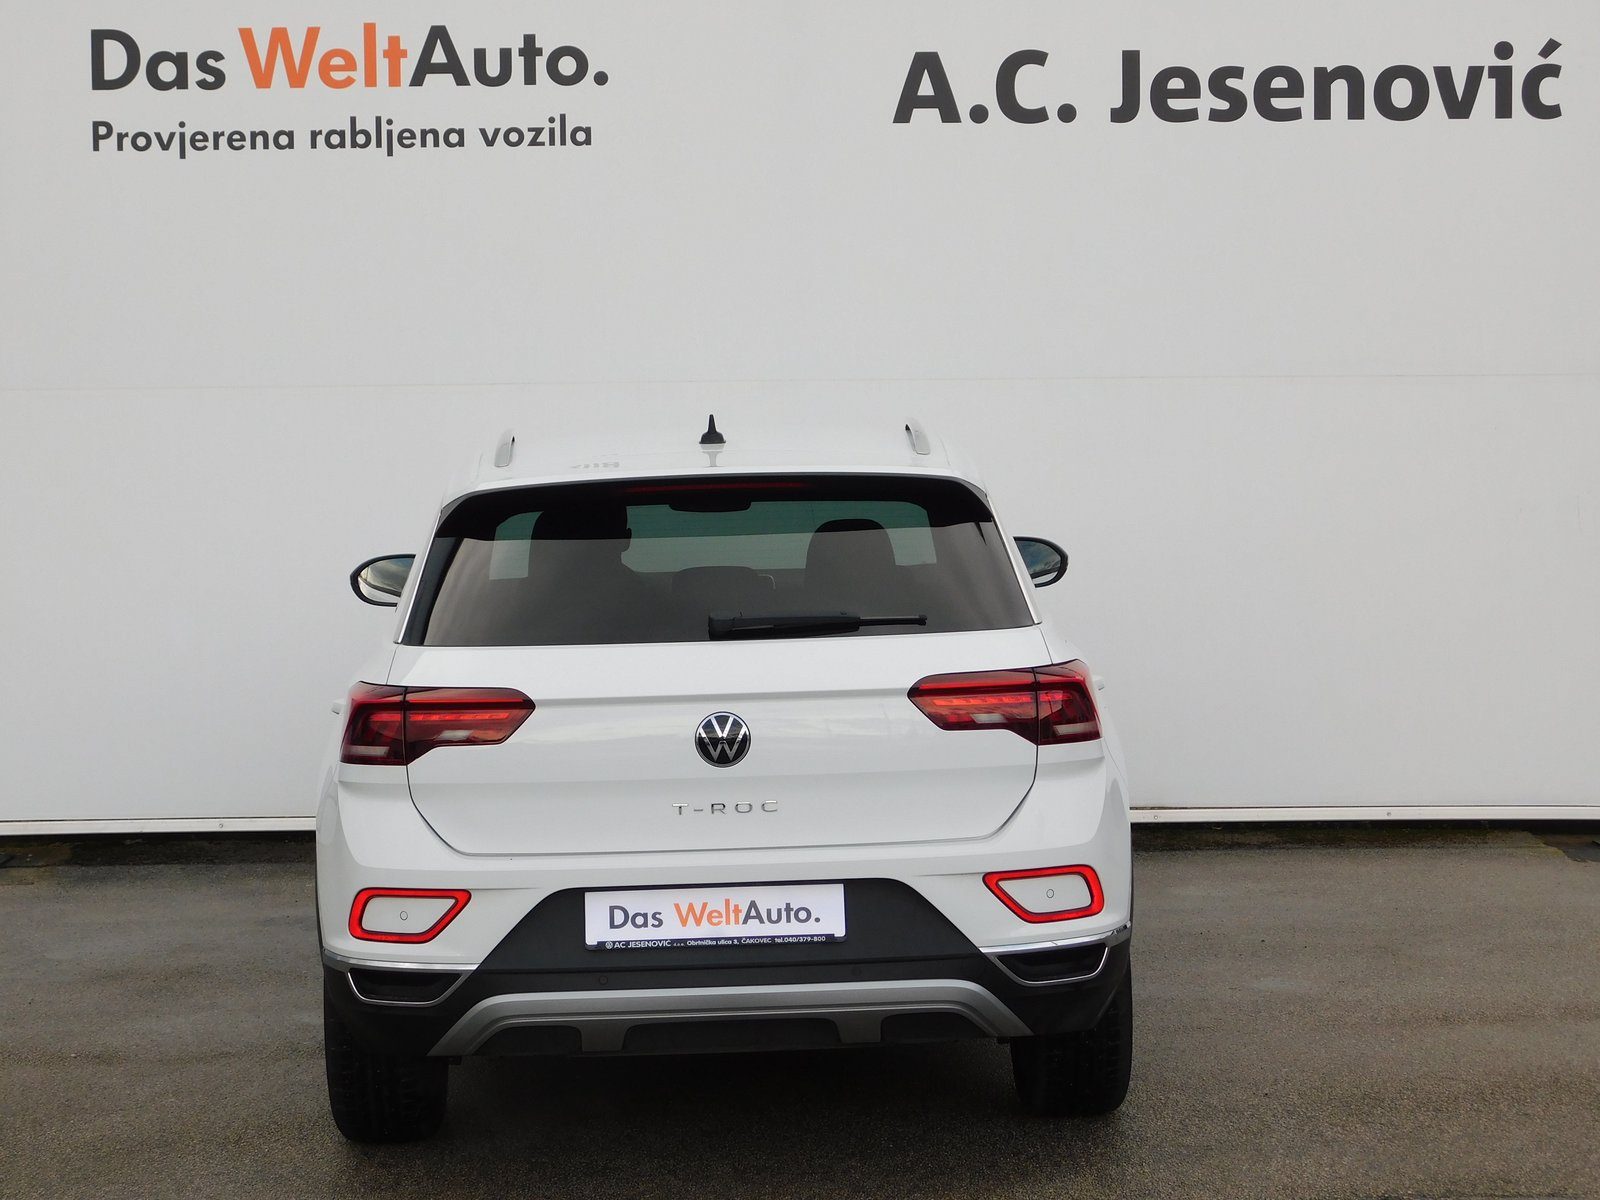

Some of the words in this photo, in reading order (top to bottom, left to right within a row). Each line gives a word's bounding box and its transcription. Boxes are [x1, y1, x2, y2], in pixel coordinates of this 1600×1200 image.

[91, 29, 225, 91] Das
[239, 23, 609, 89] WeltAuto.
[892, 49, 1076, 125] A.C.
[1110, 38, 1563, 123] Jesenović
[92, 120, 295, 160] Provjerena
[310, 116, 465, 157] rabljena
[479, 114, 592, 148] vozila
[672, 800, 778, 816] T-ROC
[608, 904, 664, 930] Das
[673, 898, 822, 928] WeltAuto.
[613, 941, 626, 949] AC
[627, 939, 672, 948] JESENOVIĆ
